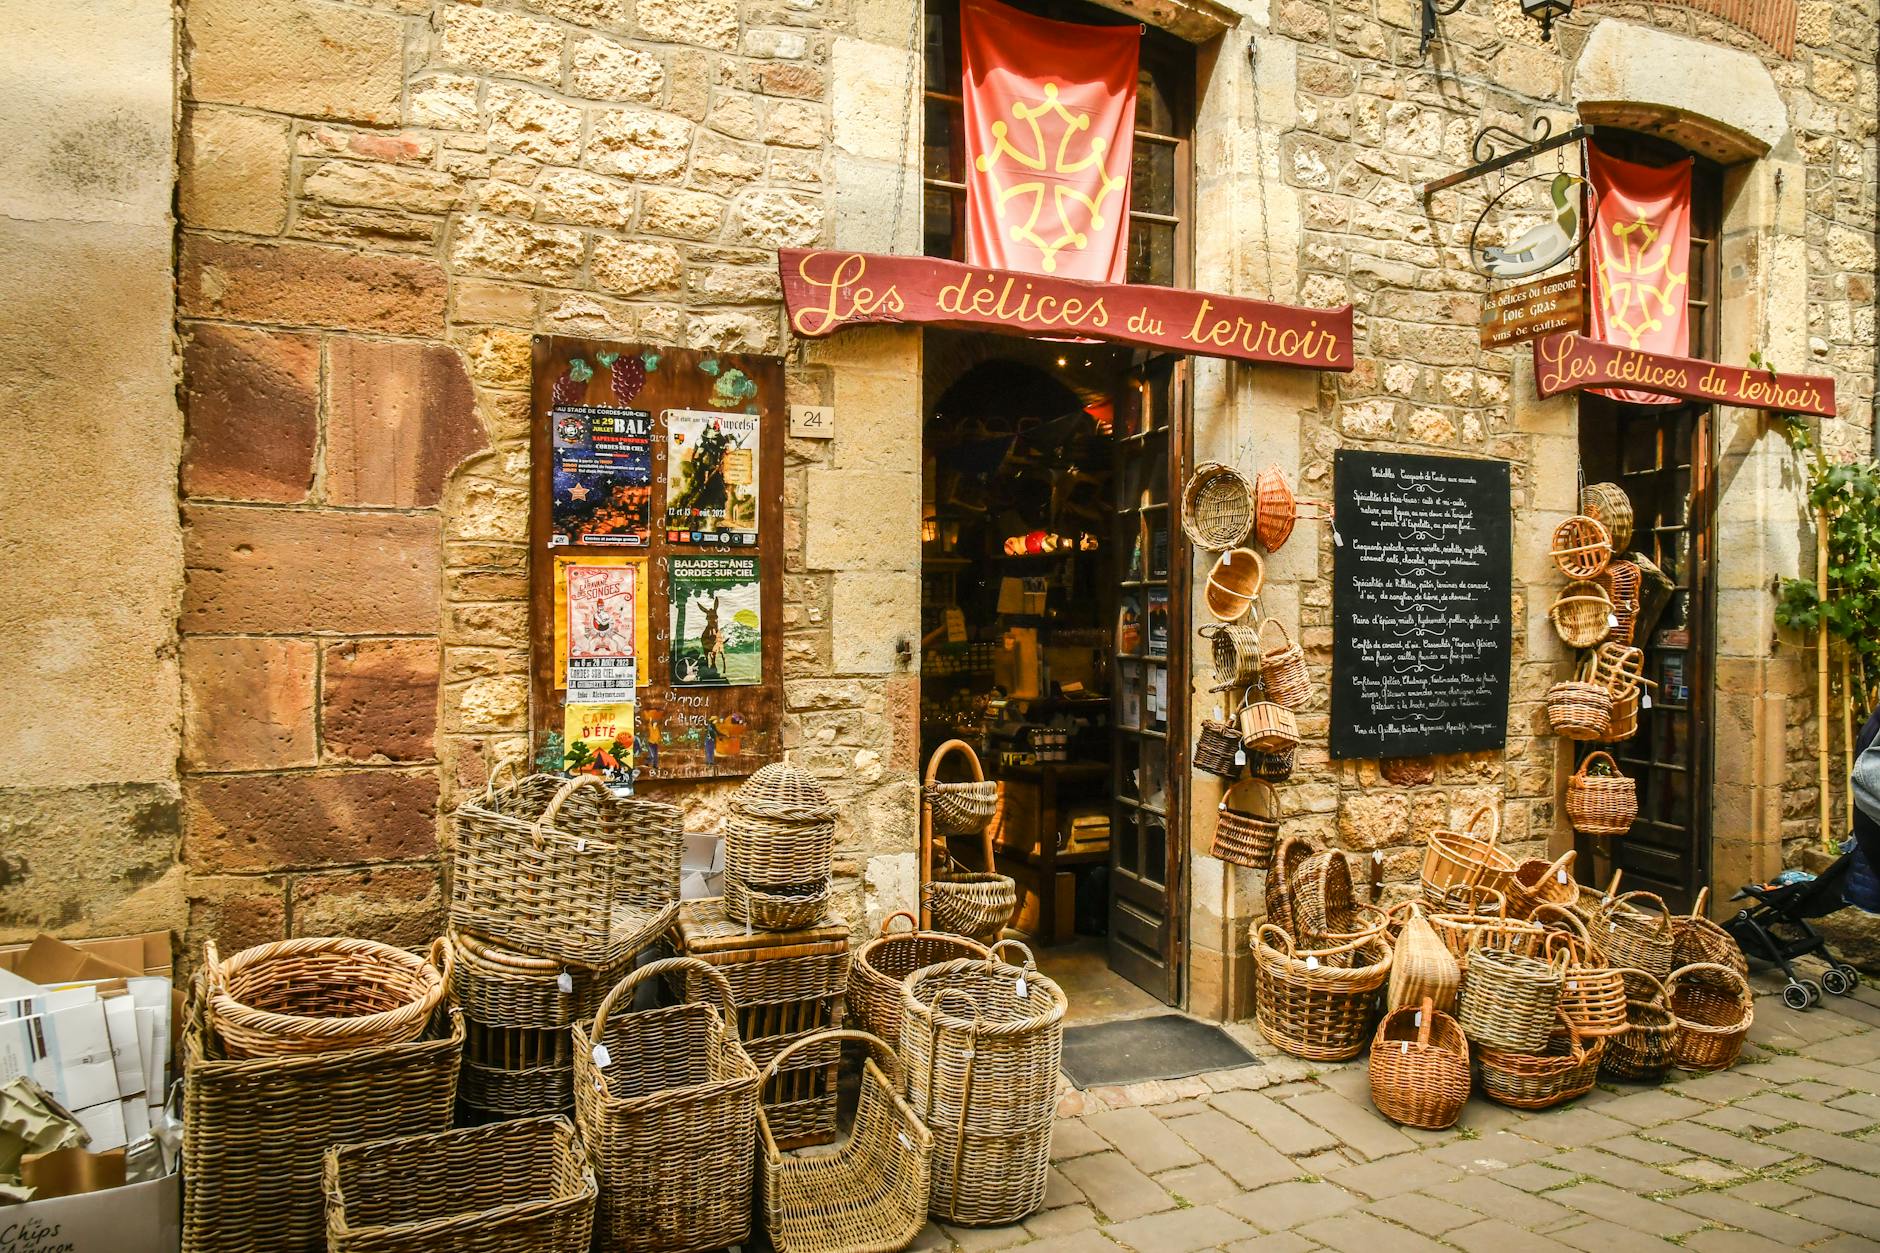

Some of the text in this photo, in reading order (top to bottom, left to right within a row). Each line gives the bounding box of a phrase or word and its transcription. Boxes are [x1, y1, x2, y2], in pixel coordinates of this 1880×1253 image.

[797, 252, 1340, 362] Les délices du terroir
[1530, 300, 1557, 317] GRAS
[1541, 334, 1825, 412] Les délices du terroir
[597, 408, 648, 417] CORDES-SUR-CIEL
[804, 411, 822, 428] 24
[614, 418, 646, 434] BAL
[1383, 493, 1390, 502] de
[675, 560, 719, 568] BALADES
[729, 559, 753, 568] ÂNES
[587, 583, 620, 600] SONGES
[1380, 590, 1388, 599] de
[1352, 614, 1369, 624] Pains
[1373, 640, 1381, 648] de
[570, 668, 590, 678] CORDES
[591, 669, 601, 678] SUR
[603, 668, 614, 678] CIEL
[583, 713, 615, 724] CAMP
[583, 724, 616, 738] D'ÉTÉ
[1353, 724, 1367, 734] Vins
[1369, 726, 1377, 734] de
[0, 1224, 61, 1245] Chips
